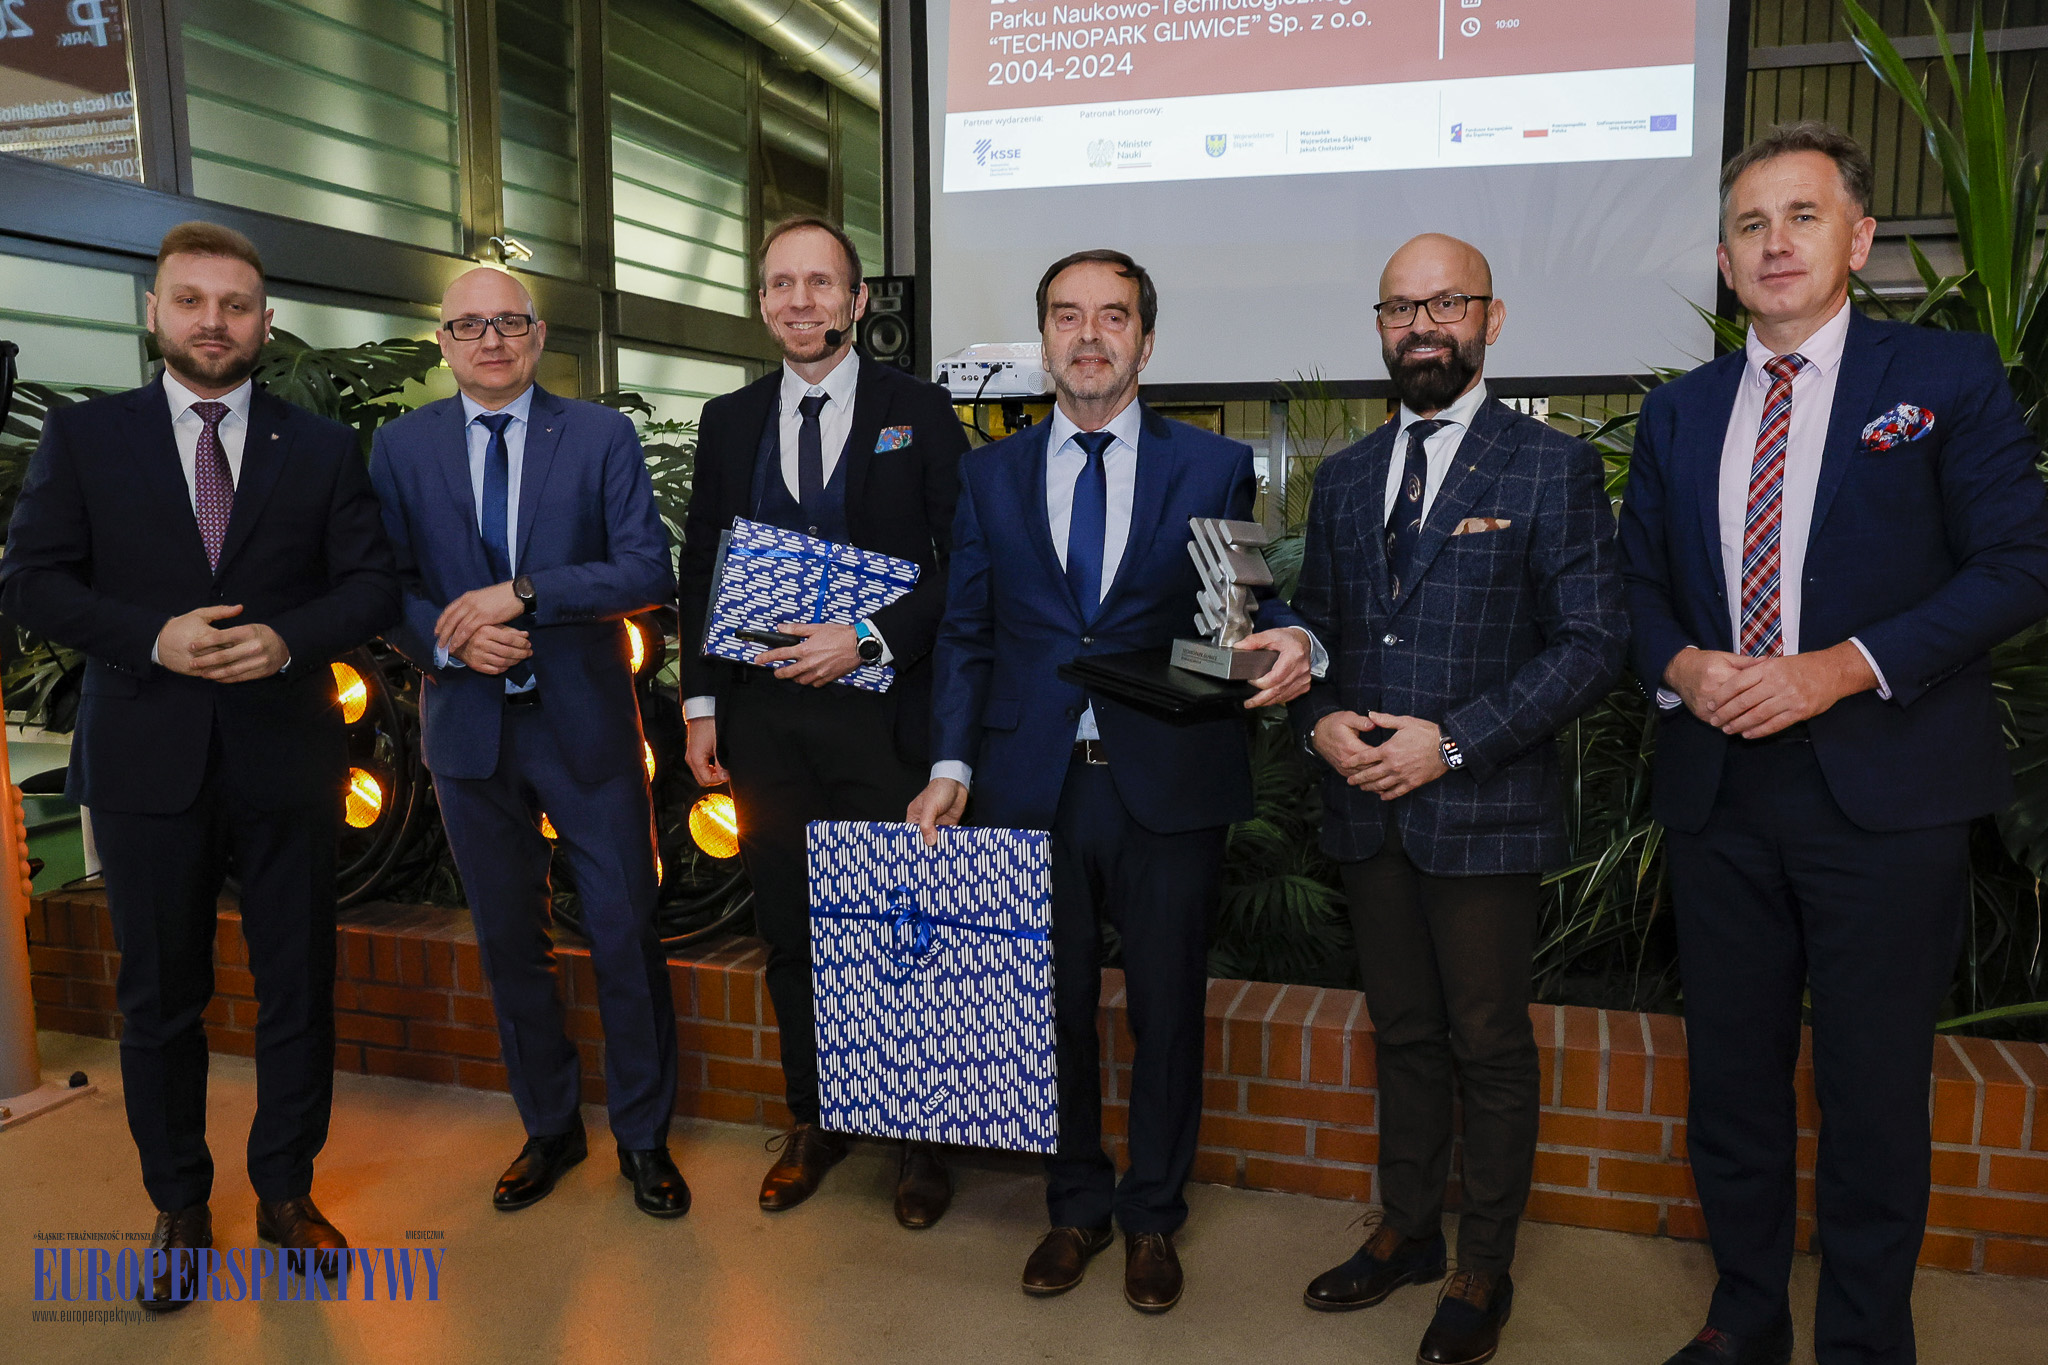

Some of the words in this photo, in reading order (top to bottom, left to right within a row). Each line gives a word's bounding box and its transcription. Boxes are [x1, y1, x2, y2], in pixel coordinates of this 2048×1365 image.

[990, 9, 1046, 30] Parku
[1268, 12, 1304, 37] Sp.
[1311, 14, 1324, 30] z
[1330, 10, 1372, 29] o.o.
[1495, 19, 1520, 29] 10:00
[988, 52, 1134, 86] 2004-2024
[1079, 108, 1116, 118] Patronat
[1118, 106, 1164, 116] honorowy:
[963, 118, 993, 127] Partner
[995, 114, 1044, 126] wydarzenia:
[1117, 139, 1153, 149] Minister
[990, 148, 1022, 160] KSSE
[1117, 150, 1142, 160] Nauki
[921, 1085, 950, 1115] KSSE
